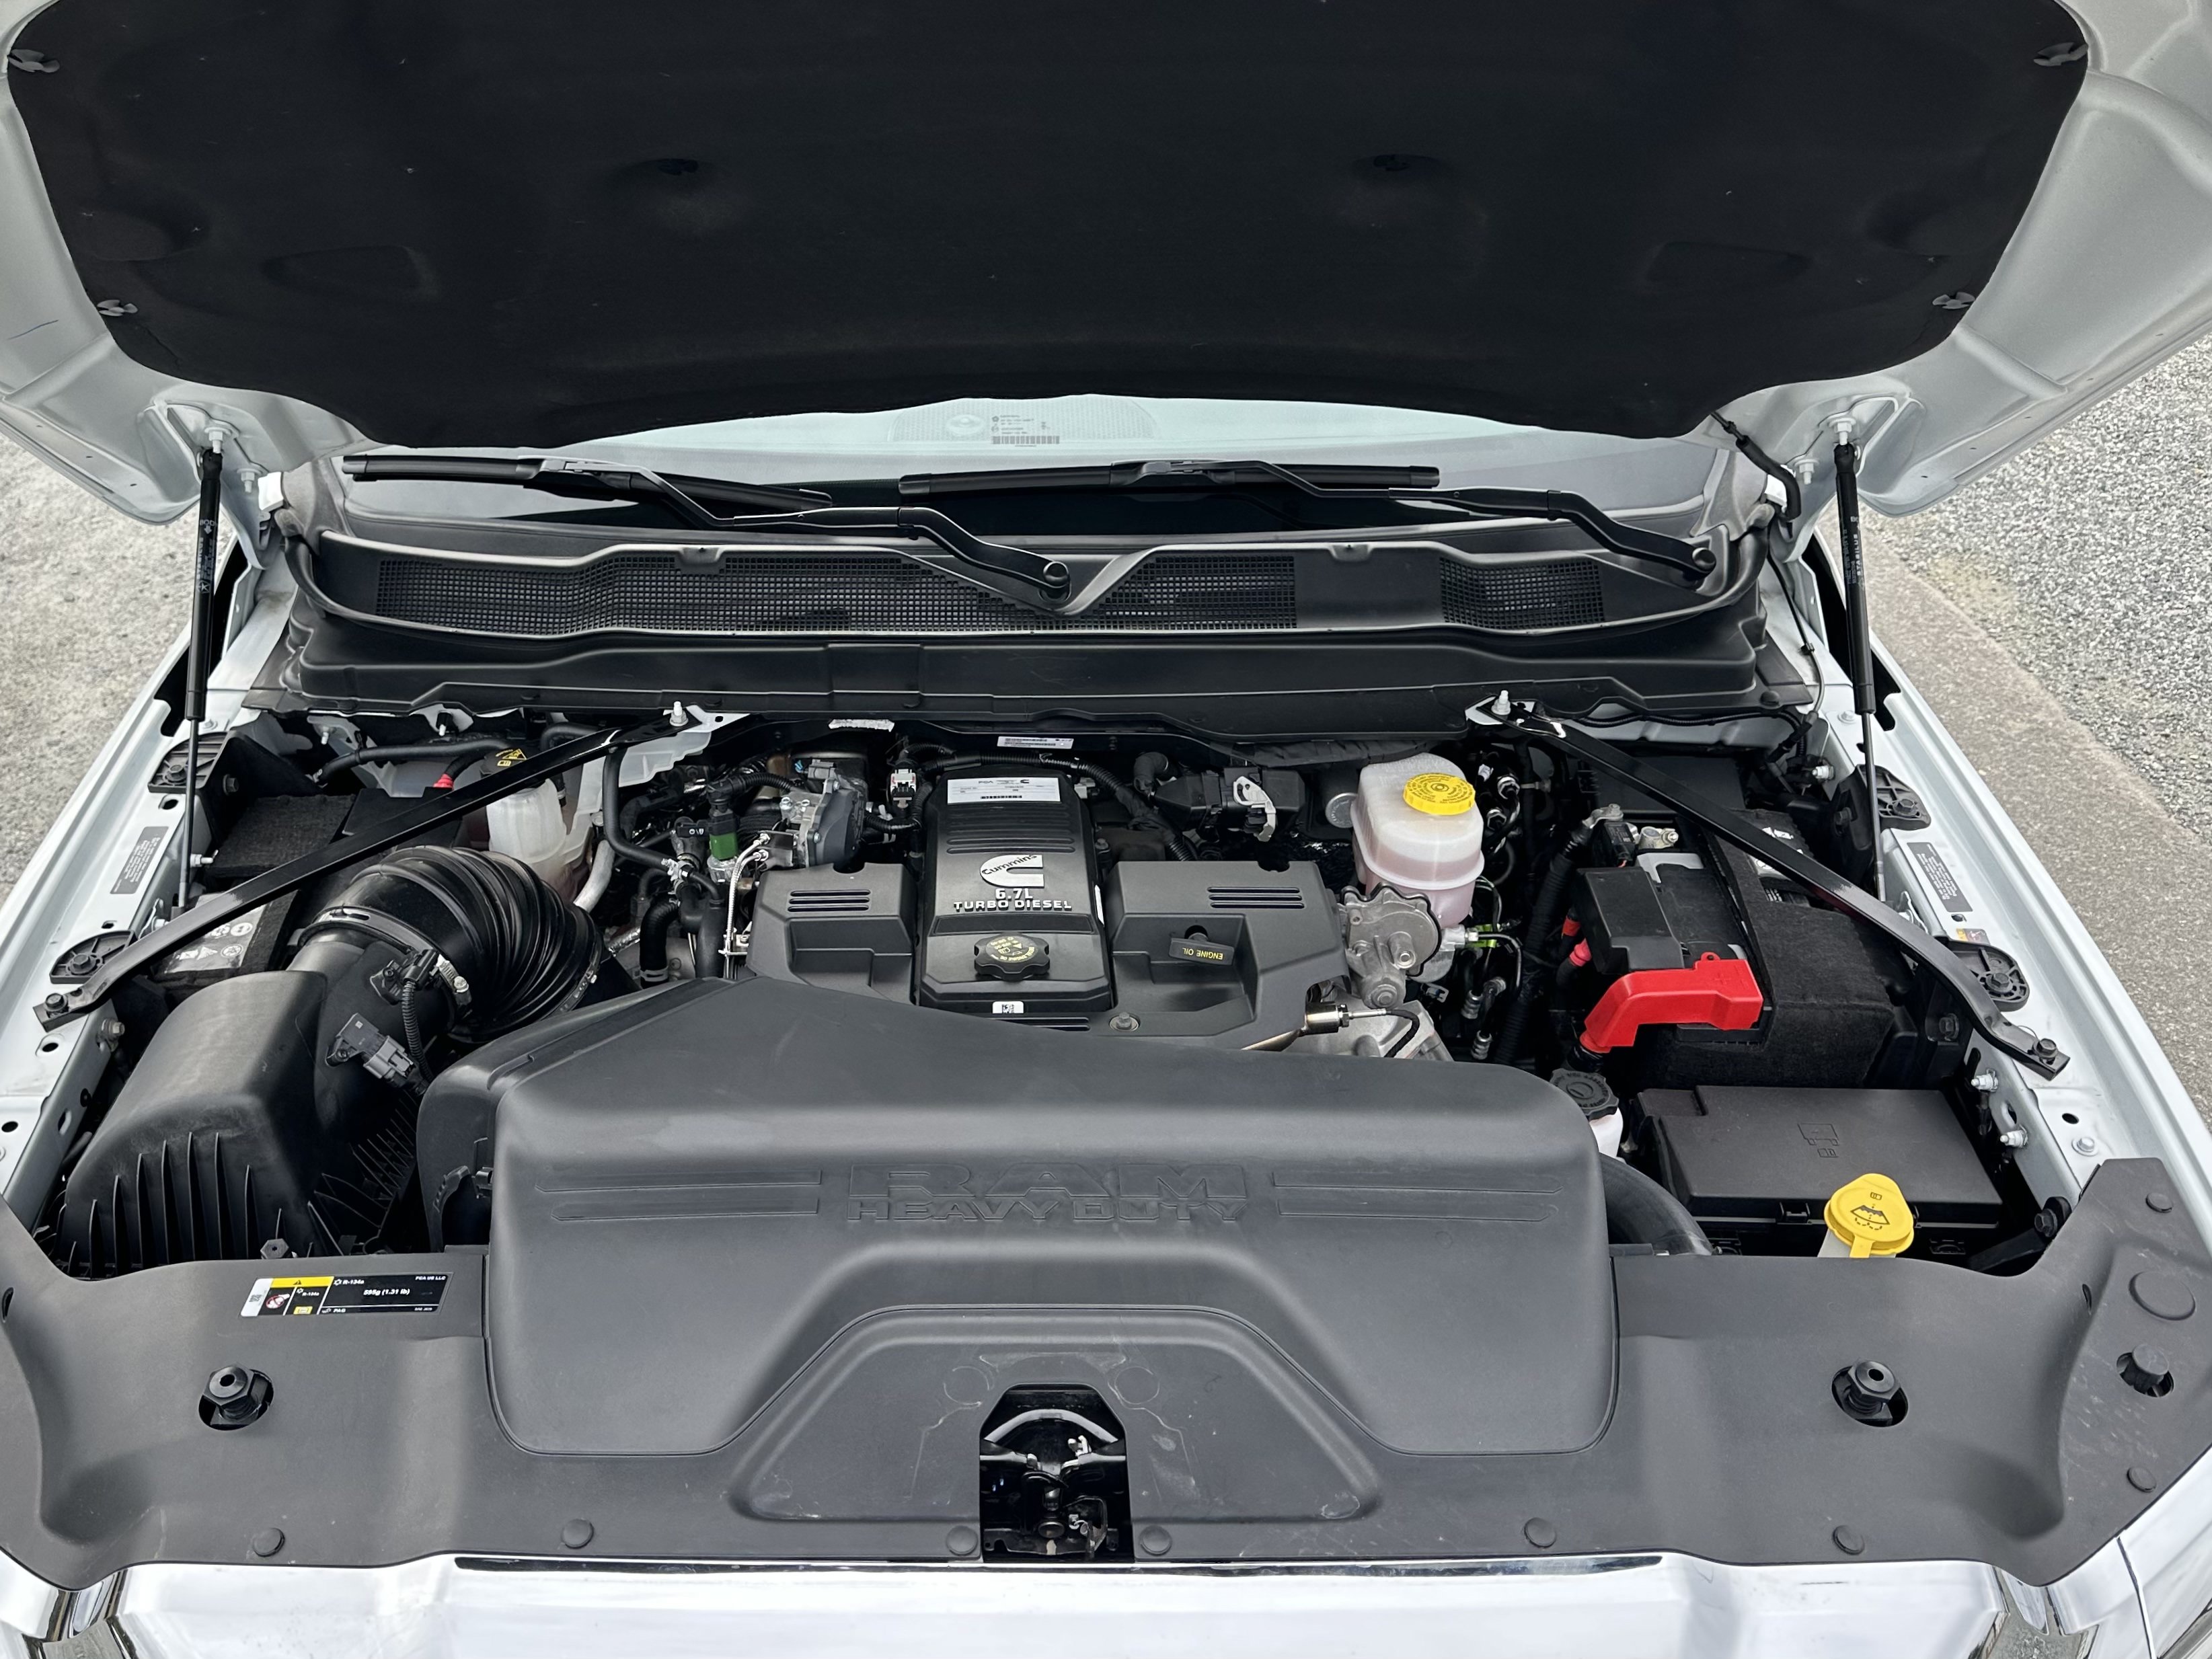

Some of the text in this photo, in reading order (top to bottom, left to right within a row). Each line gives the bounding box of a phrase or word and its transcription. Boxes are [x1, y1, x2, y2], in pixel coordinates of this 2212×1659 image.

[1854, 534, 1862, 576] STABILUS
[981, 855, 1037, 874] Cummins
[995, 888, 1033, 900] 6.7L
[954, 899, 1072, 911] TURBO DIESEL
[1182, 948, 1223, 960] ENGINE OIL
[849, 1163, 1247, 1198] RAM
[847, 1200, 1249, 1221] HEAVY DUTY
